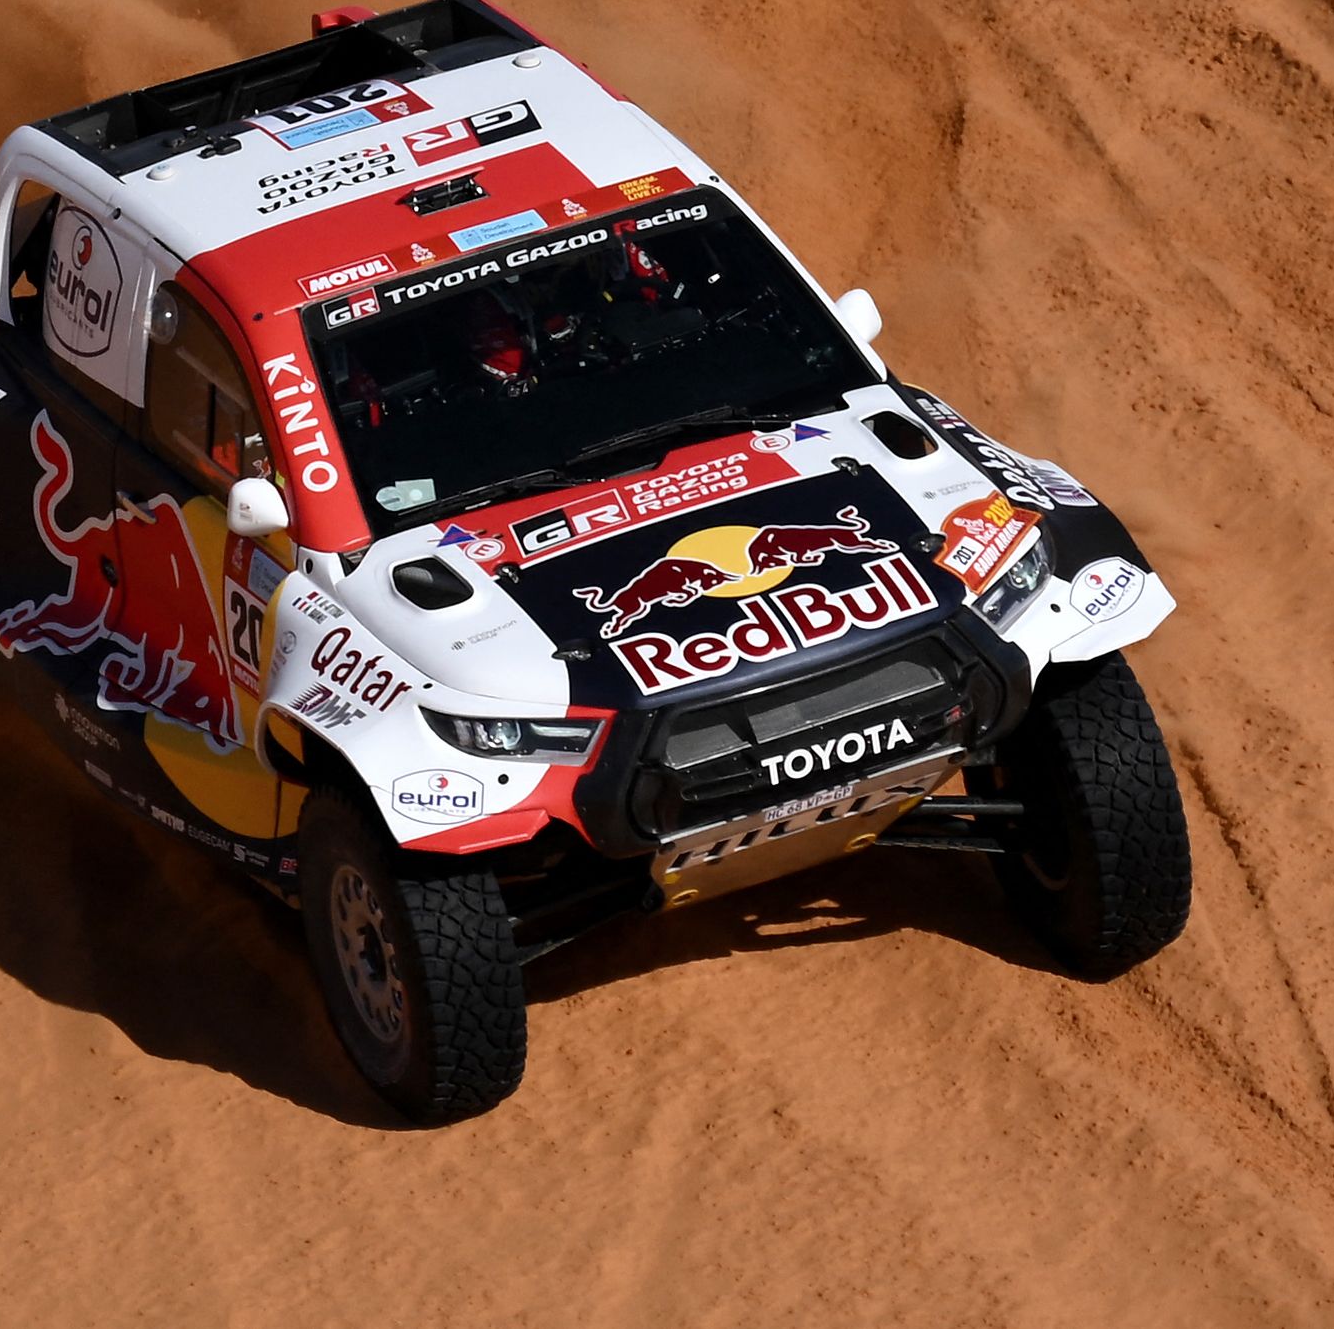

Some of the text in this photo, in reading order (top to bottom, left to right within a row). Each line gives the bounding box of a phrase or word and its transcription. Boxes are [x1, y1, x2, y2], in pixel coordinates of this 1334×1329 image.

[410, 102, 530, 153] GR
[256, 165, 406, 215] TOYOTA
[257, 142, 390, 190] Racing
[263, 153, 396, 201] GAZOO
[628, 189, 651, 202] LIVE
[309, 261, 389, 297] MOTUL
[327, 203, 708, 328] GR TOYOTA GAZOO Racing
[49, 249, 113, 333] eurol
[624, 451, 750, 495] TOYOTA
[631, 464, 745, 506] GAZOO
[636, 475, 749, 516] Racing
[523, 502, 625, 552] GR
[952, 545, 976, 566] 201
[972, 543, 1002, 578] SAUDI
[1084, 566, 1136, 617] eurol
[615, 555, 933, 690] Red Bull
[310, 627, 413, 713] Qatar
[761, 718, 915, 786] TOYOTA
[398, 790, 477, 808] eurol
[767, 805, 785, 821] HC
